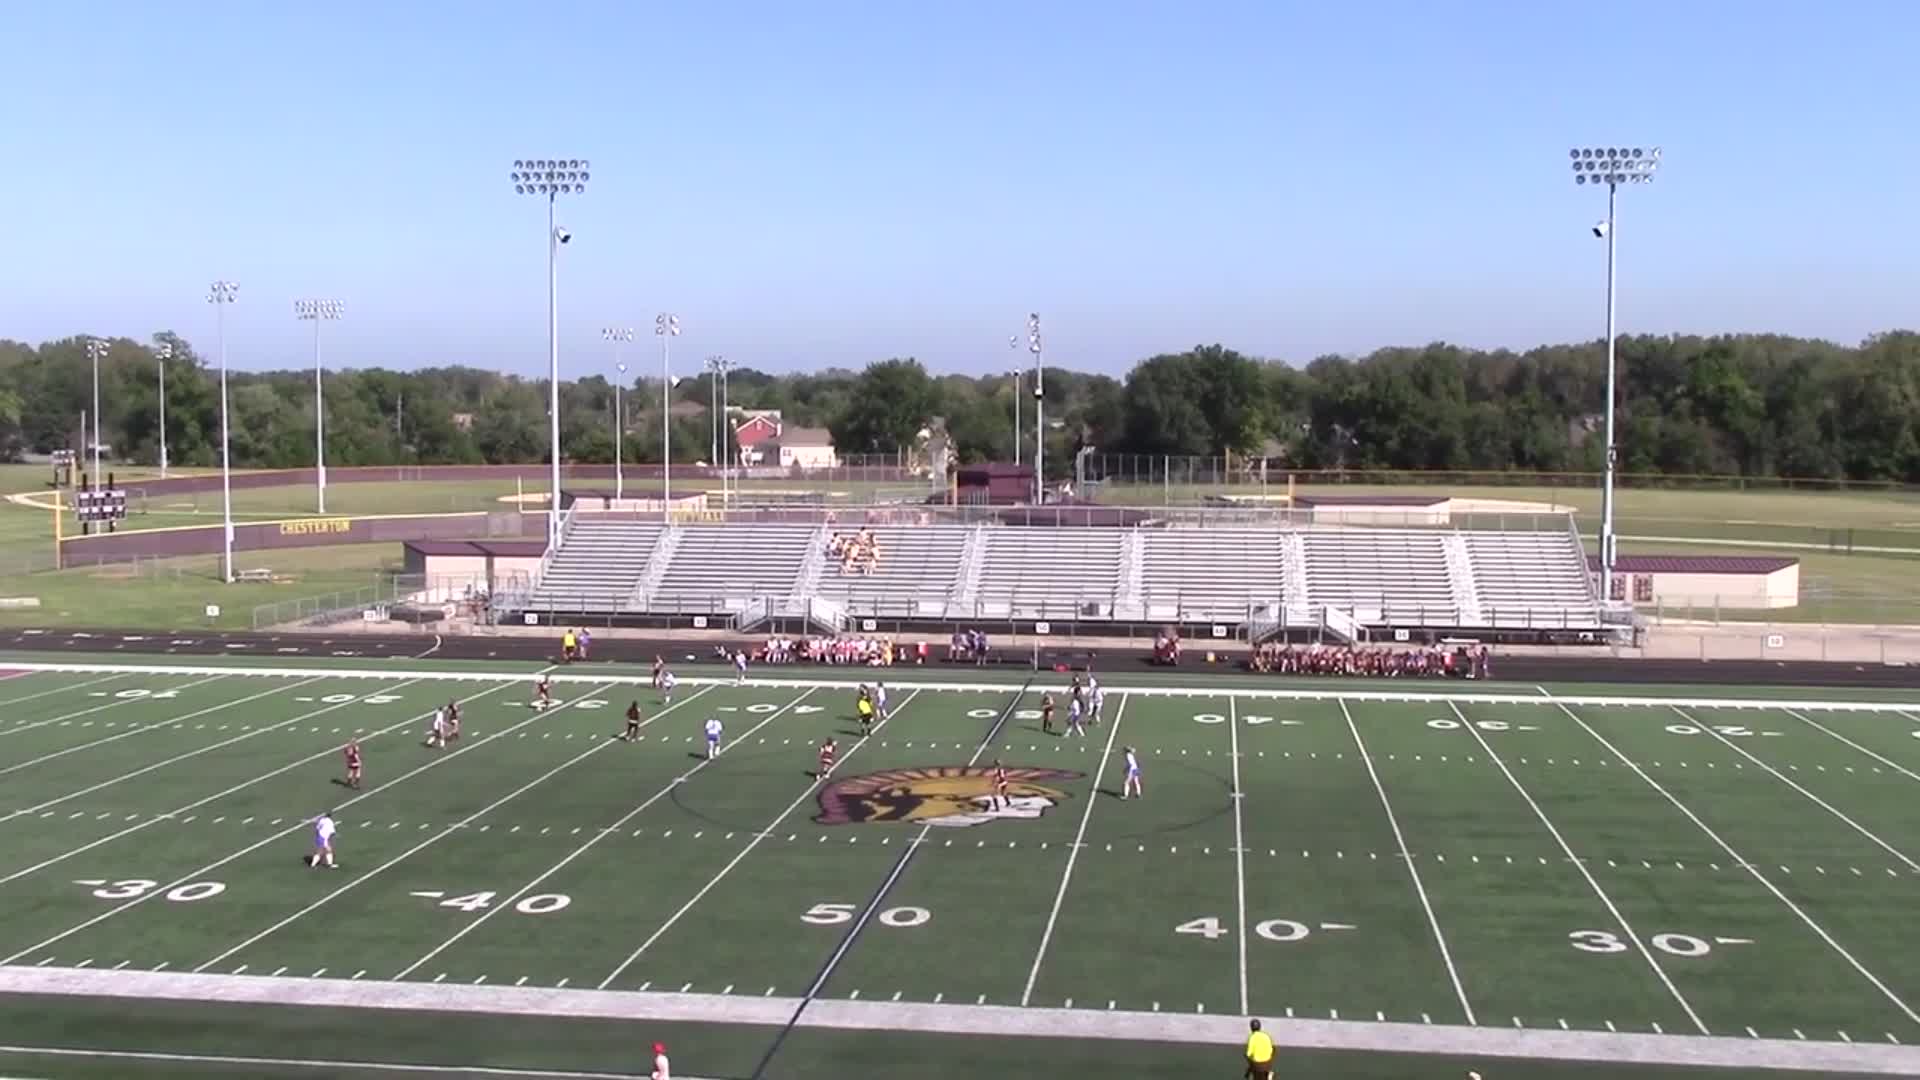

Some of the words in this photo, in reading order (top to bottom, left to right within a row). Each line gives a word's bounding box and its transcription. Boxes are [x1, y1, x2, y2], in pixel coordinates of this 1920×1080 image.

[93, 879, 226, 901] 30
[440, 891, 571, 913] 40
[800, 903, 931, 926] 50
[1175, 917, 1309, 941] 40
[1569, 930, 1711, 956] 30
